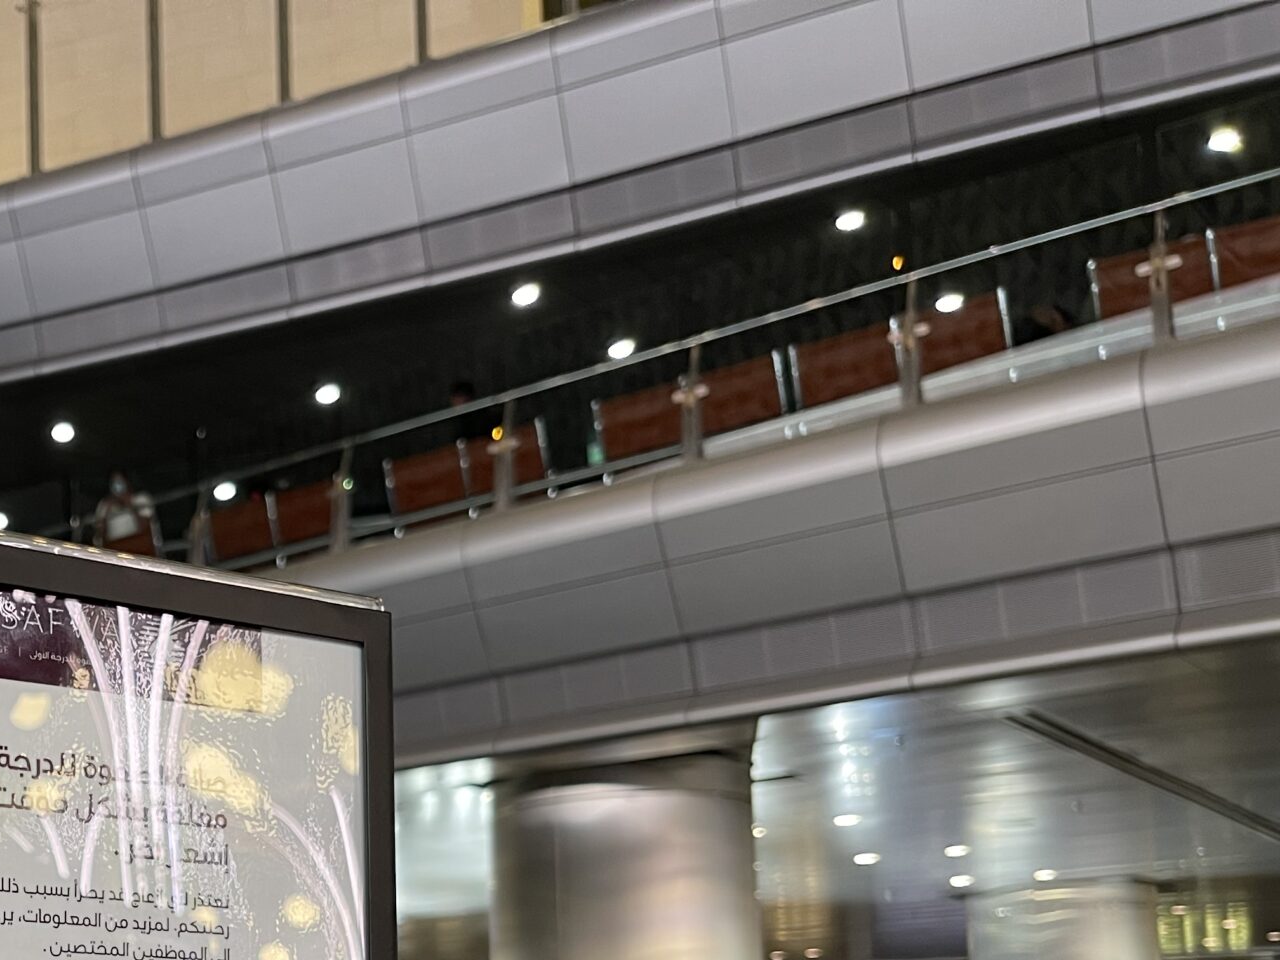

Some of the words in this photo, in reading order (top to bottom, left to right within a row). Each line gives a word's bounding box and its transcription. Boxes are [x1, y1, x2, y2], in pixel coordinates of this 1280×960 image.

[23, 884, 70, 901] بسبب
[192, 892, 230, 911] نعتذر
[18, 908, 102, 929] المعلومات،
[105, 916, 129, 932] من
[132, 915, 170, 935] لمزيد
[43, 940, 130, 958] المختصين.
